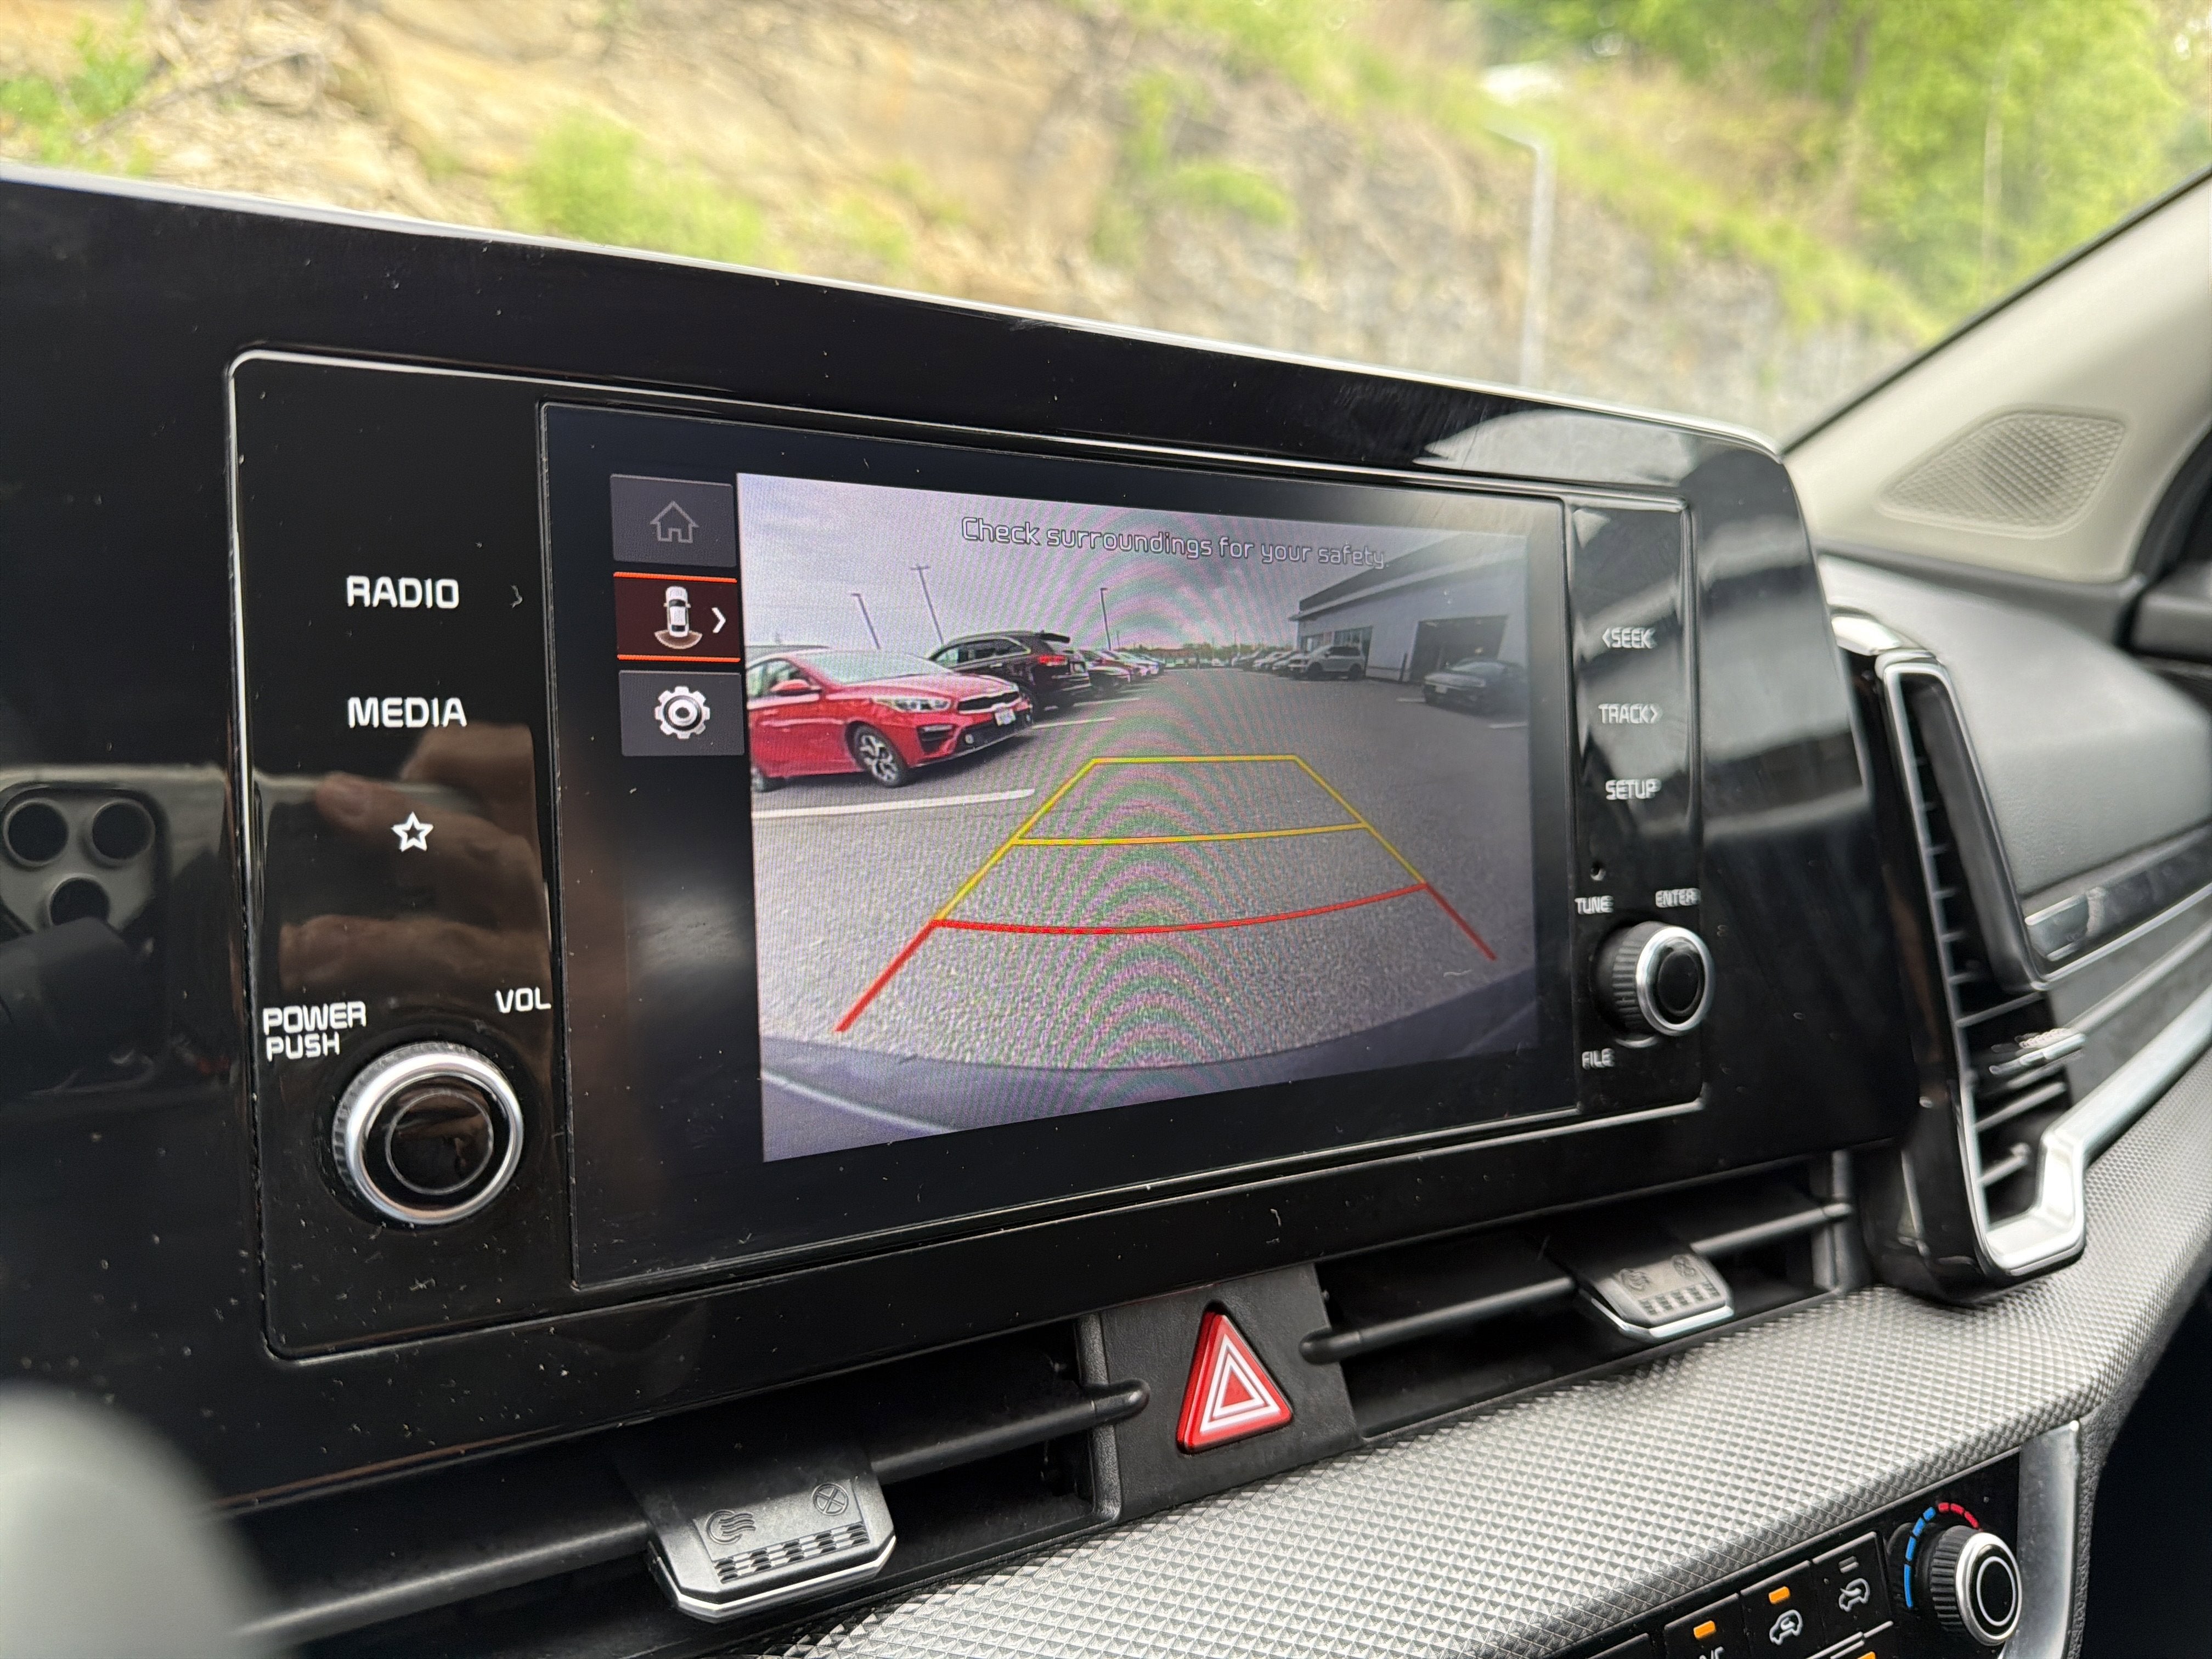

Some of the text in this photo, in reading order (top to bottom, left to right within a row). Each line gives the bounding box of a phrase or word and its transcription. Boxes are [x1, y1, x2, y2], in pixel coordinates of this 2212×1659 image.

[962, 517, 1040, 545] Check
[1047, 528, 1212, 560] surroundings
[1219, 537, 1254, 558] for
[1262, 543, 1311, 563] your
[346, 575, 460, 609] RADIO
[347, 697, 467, 729] MEDIA
[1605, 778, 1662, 800] SETUP
[1574, 895, 1614, 915] TUNE
[1655, 888, 1701, 908] ENTER
[495, 987, 551, 1014] VOL
[263, 1001, 366, 1035] POWER
[266, 1032, 340, 1062] PUSH
[1582, 1048, 1616, 1070] FILE
